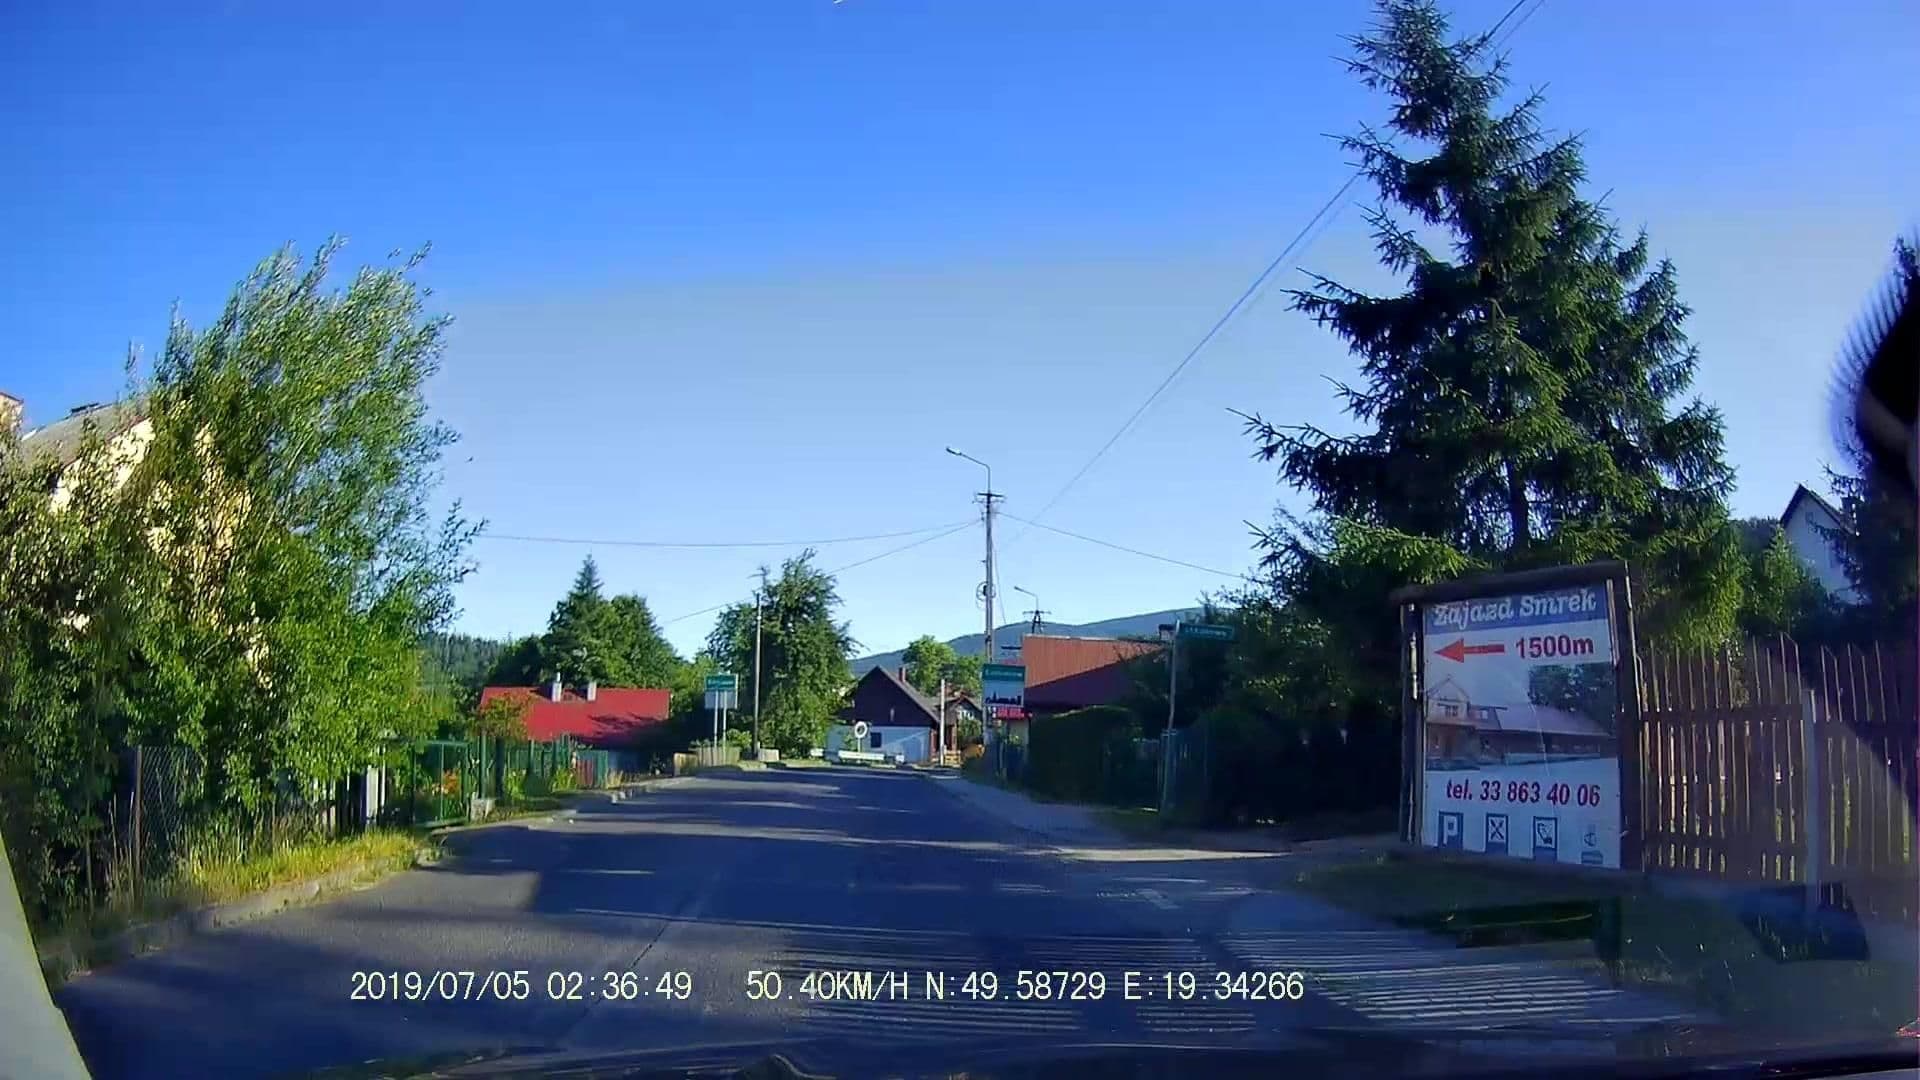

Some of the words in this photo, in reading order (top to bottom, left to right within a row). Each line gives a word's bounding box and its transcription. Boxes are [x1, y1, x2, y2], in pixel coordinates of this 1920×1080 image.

[1433, 598, 1514, 630] Zajazd
[1519, 588, 1597, 617] Smrek
[1515, 634, 1594, 659] 1500m
[1446, 779, 1472, 800] tel.
[1480, 780, 1501, 801] 33
[1507, 781, 1541, 803] 863
[1547, 783, 1570, 805] 40
[1577, 784, 1600, 807] 06
